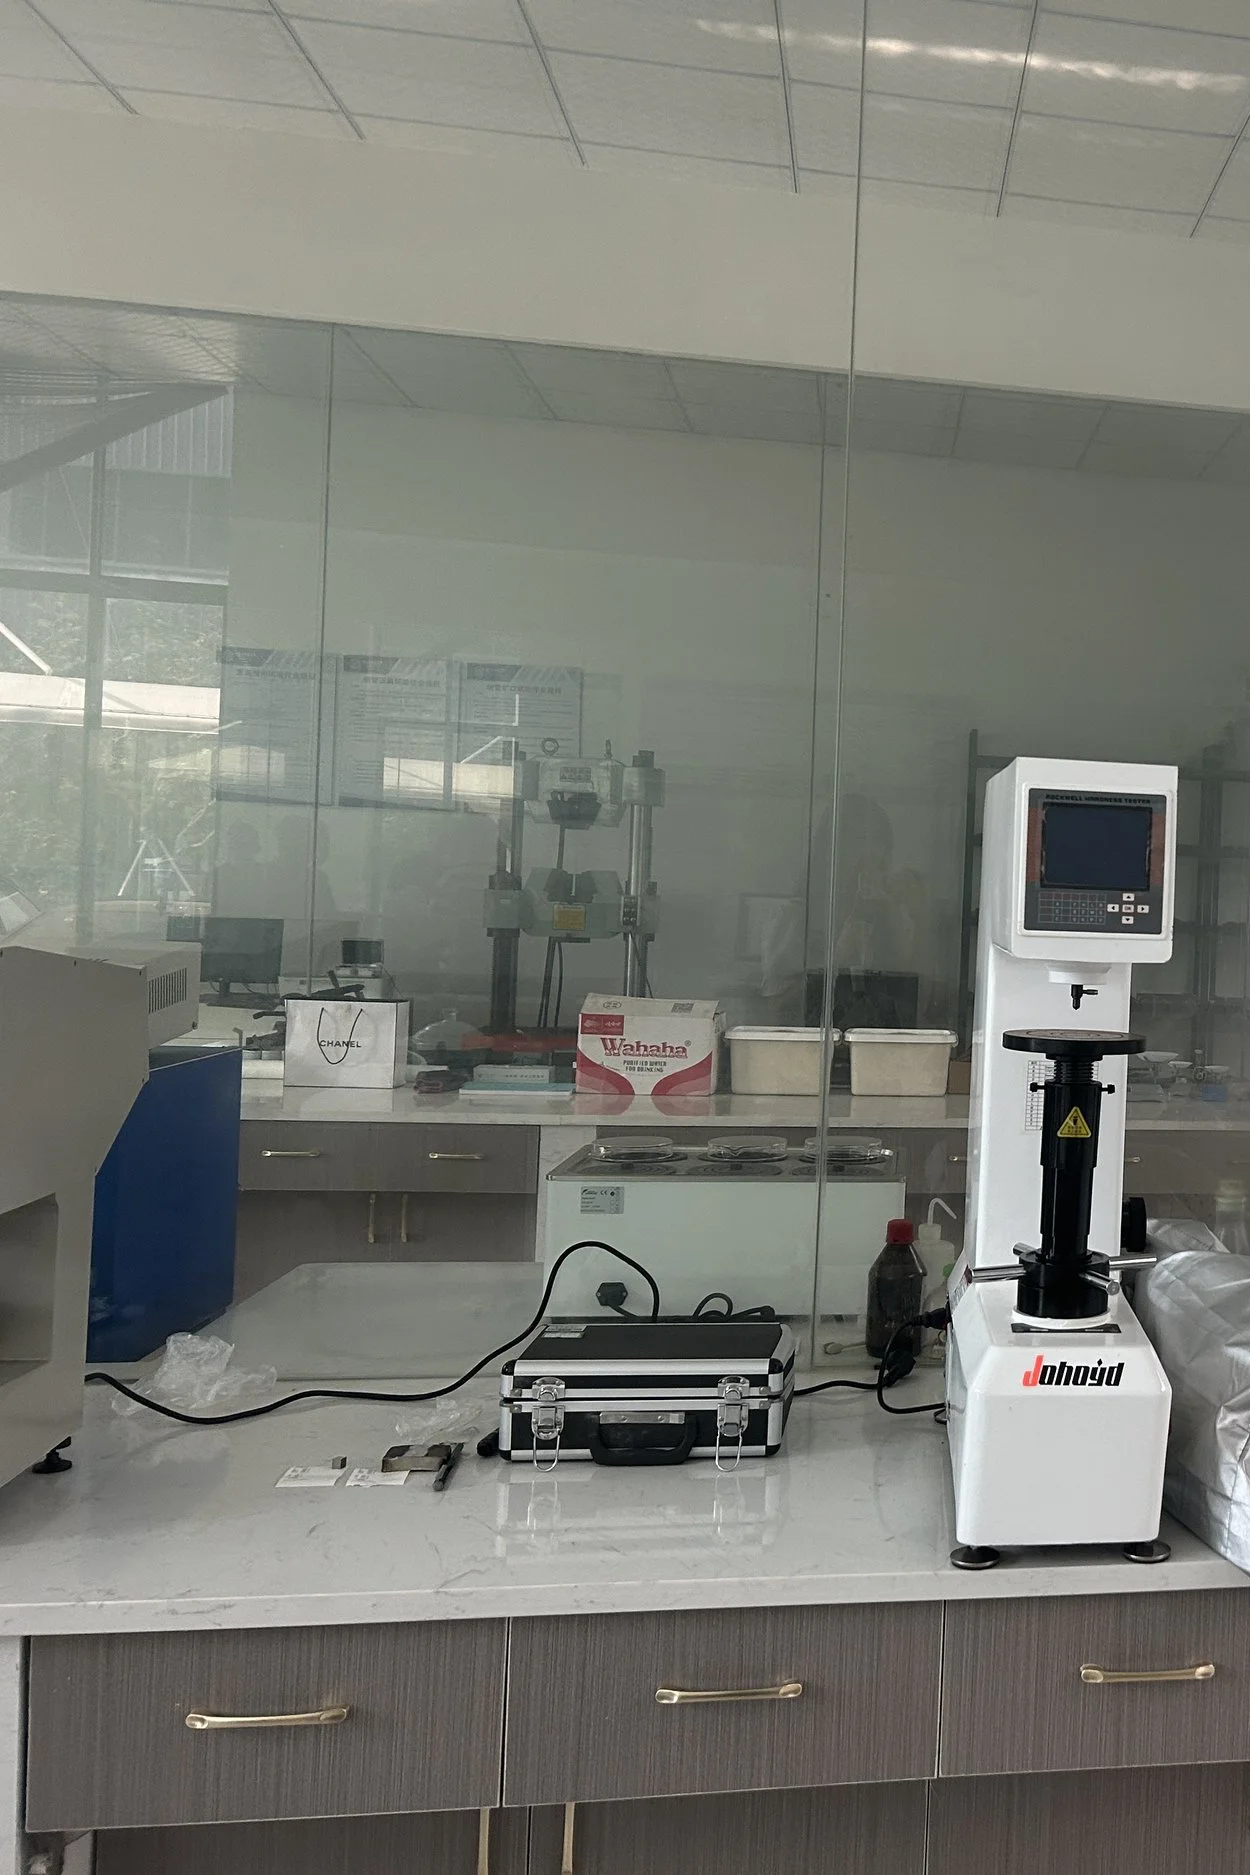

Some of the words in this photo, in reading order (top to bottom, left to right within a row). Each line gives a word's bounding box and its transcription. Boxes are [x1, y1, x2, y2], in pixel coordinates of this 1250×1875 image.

[1045, 793, 1083, 802] ROCKWELL
[1084, 796, 1123, 804] HARDNESS
[1124, 797, 1151, 805] TESTER
[319, 1039, 362, 1048] CHANEL
[600, 1037, 688, 1059] Wahaha
